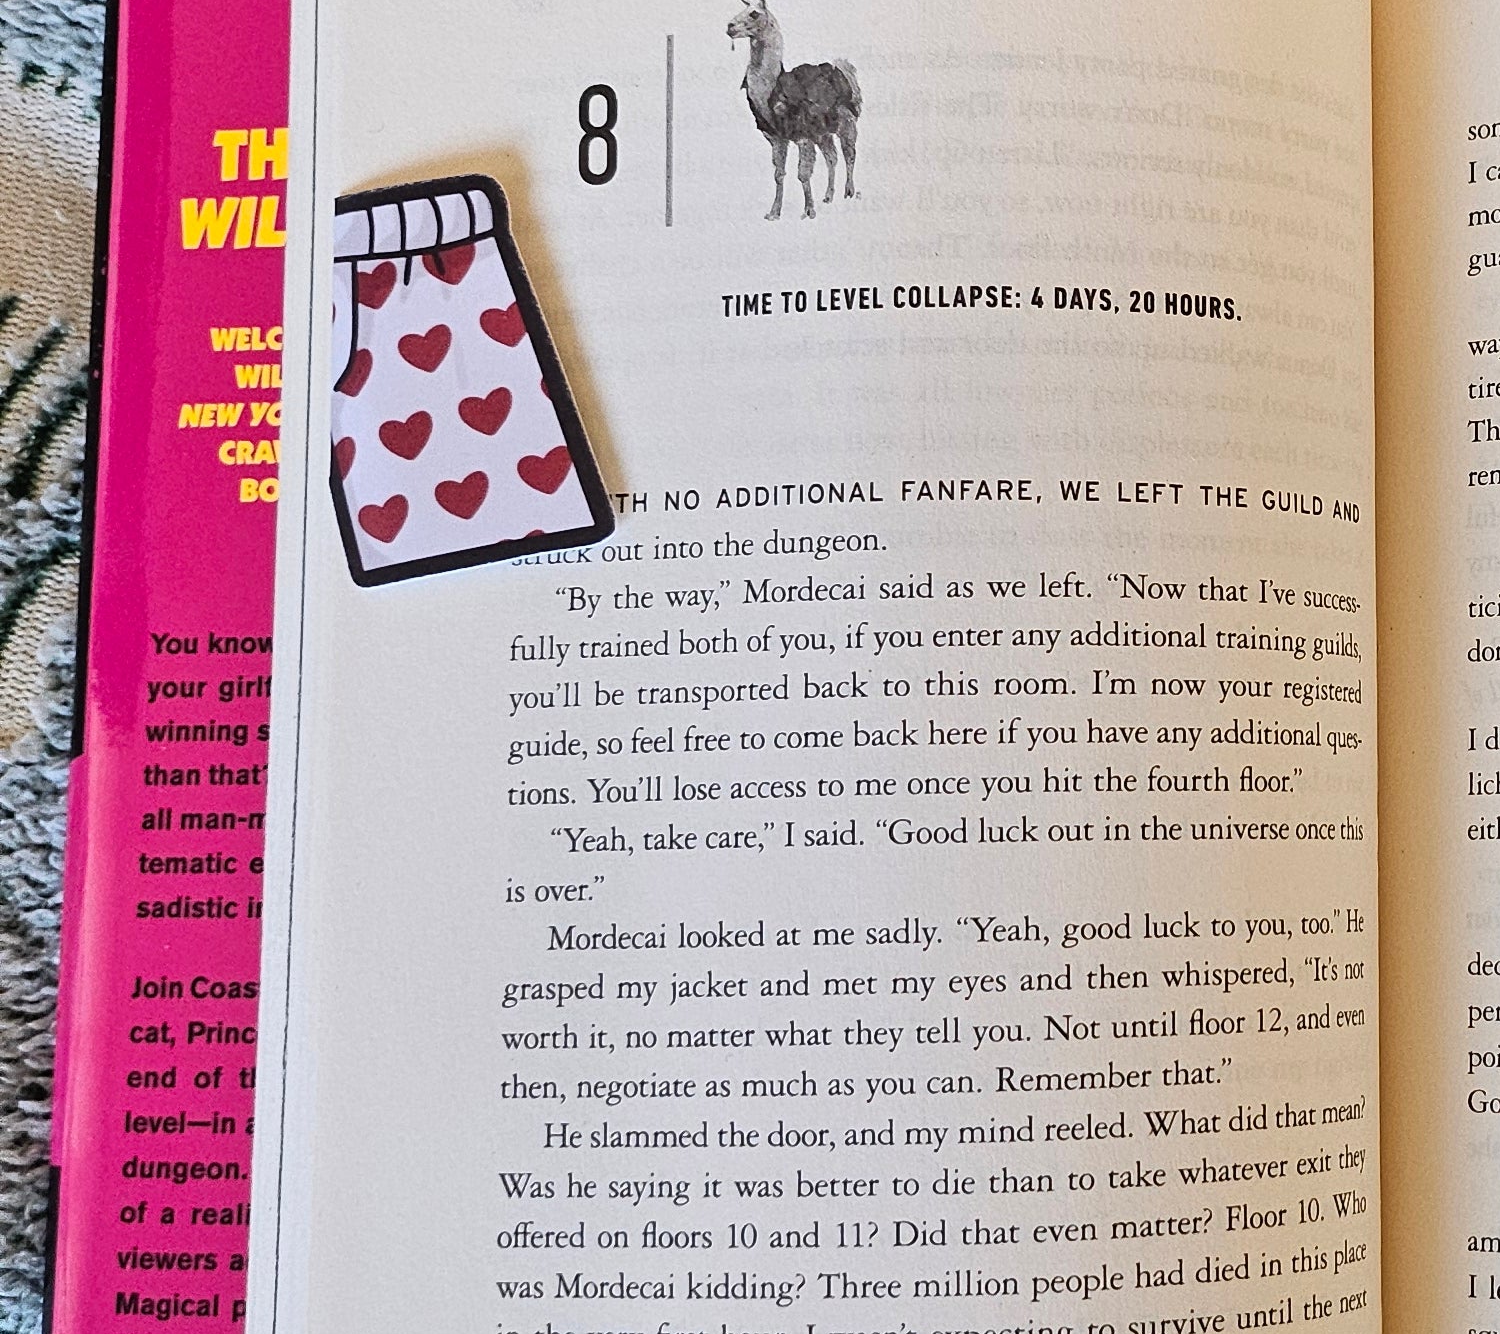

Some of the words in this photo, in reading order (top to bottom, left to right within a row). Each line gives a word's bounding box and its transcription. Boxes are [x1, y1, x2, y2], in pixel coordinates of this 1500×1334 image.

[578, 83, 618, 185] 8
[722, 293, 772, 317] TIME
[781, 291, 807, 313] TO
[817, 287, 883, 311] LEVEL
[894, 286, 1020, 308] COLLAPSE:
[1031, 287, 1044, 308] 4
[1055, 287, 1124, 314] DAYS,
[1130, 290, 1155, 313] 20
[1165, 293, 1241, 321] HOURS.
[178, 403, 244, 429] NEW
[219, 440, 280, 466] CRA
[665, 490, 700, 511] NO
[716, 482, 883, 508] ADDITIONAL
[902, 480, 1041, 504] FANFARE,
[1060, 480, 1099, 501] WE
[1118, 482, 1183, 504] LEFT
[1200, 486, 1248, 508] THE
[1262, 490, 1322, 515] GUILD
[1333, 500, 1359, 523] AND
[602, 543, 643, 562] out
[653, 536, 703, 559] into
[714, 532, 754, 556] the
[764, 529, 886, 560] dungeon.
[614, 584, 653, 609] the
[742, 575, 866, 604] Mordecai
[879, 573, 934, 599] said
[947, 582, 974, 598] as
[986, 581, 1026, 598] we
[1039, 571, 1091, 598] left.
[1198, 576, 1248, 602] that
[1304, 591, 1360, 613] success-
[151, 633, 198, 655] You
[147, 681, 207, 703] your
[146, 720, 248, 746] winning
[143, 764, 200, 786] than
[141, 807, 171, 831] all
[139, 852, 237, 874] tematic
[137, 895, 238, 918] sadistic
[131, 976, 183, 1000] Join
[129, 1022, 176, 1048] cat,
[127, 1066, 176, 1089] end
[194, 1066, 222, 1089] of
[501, 1073, 566, 1104] then,
[577, 1073, 696, 1106] negotiate
[706, 1080, 730, 1097] as
[742, 1070, 817, 1097] much
[828, 1079, 854, 1096] as
[866, 1078, 916, 1103] you
[927, 1076, 982, 1094] can.
[996, 1061, 1152, 1092] Remember
[122, 1156, 248, 1185] dungeon.
[120, 1201, 146, 1225] of
[160, 1206, 175, 1225] a
[117, 1248, 218, 1271] viewers
[115, 1293, 219, 1322] Magical
